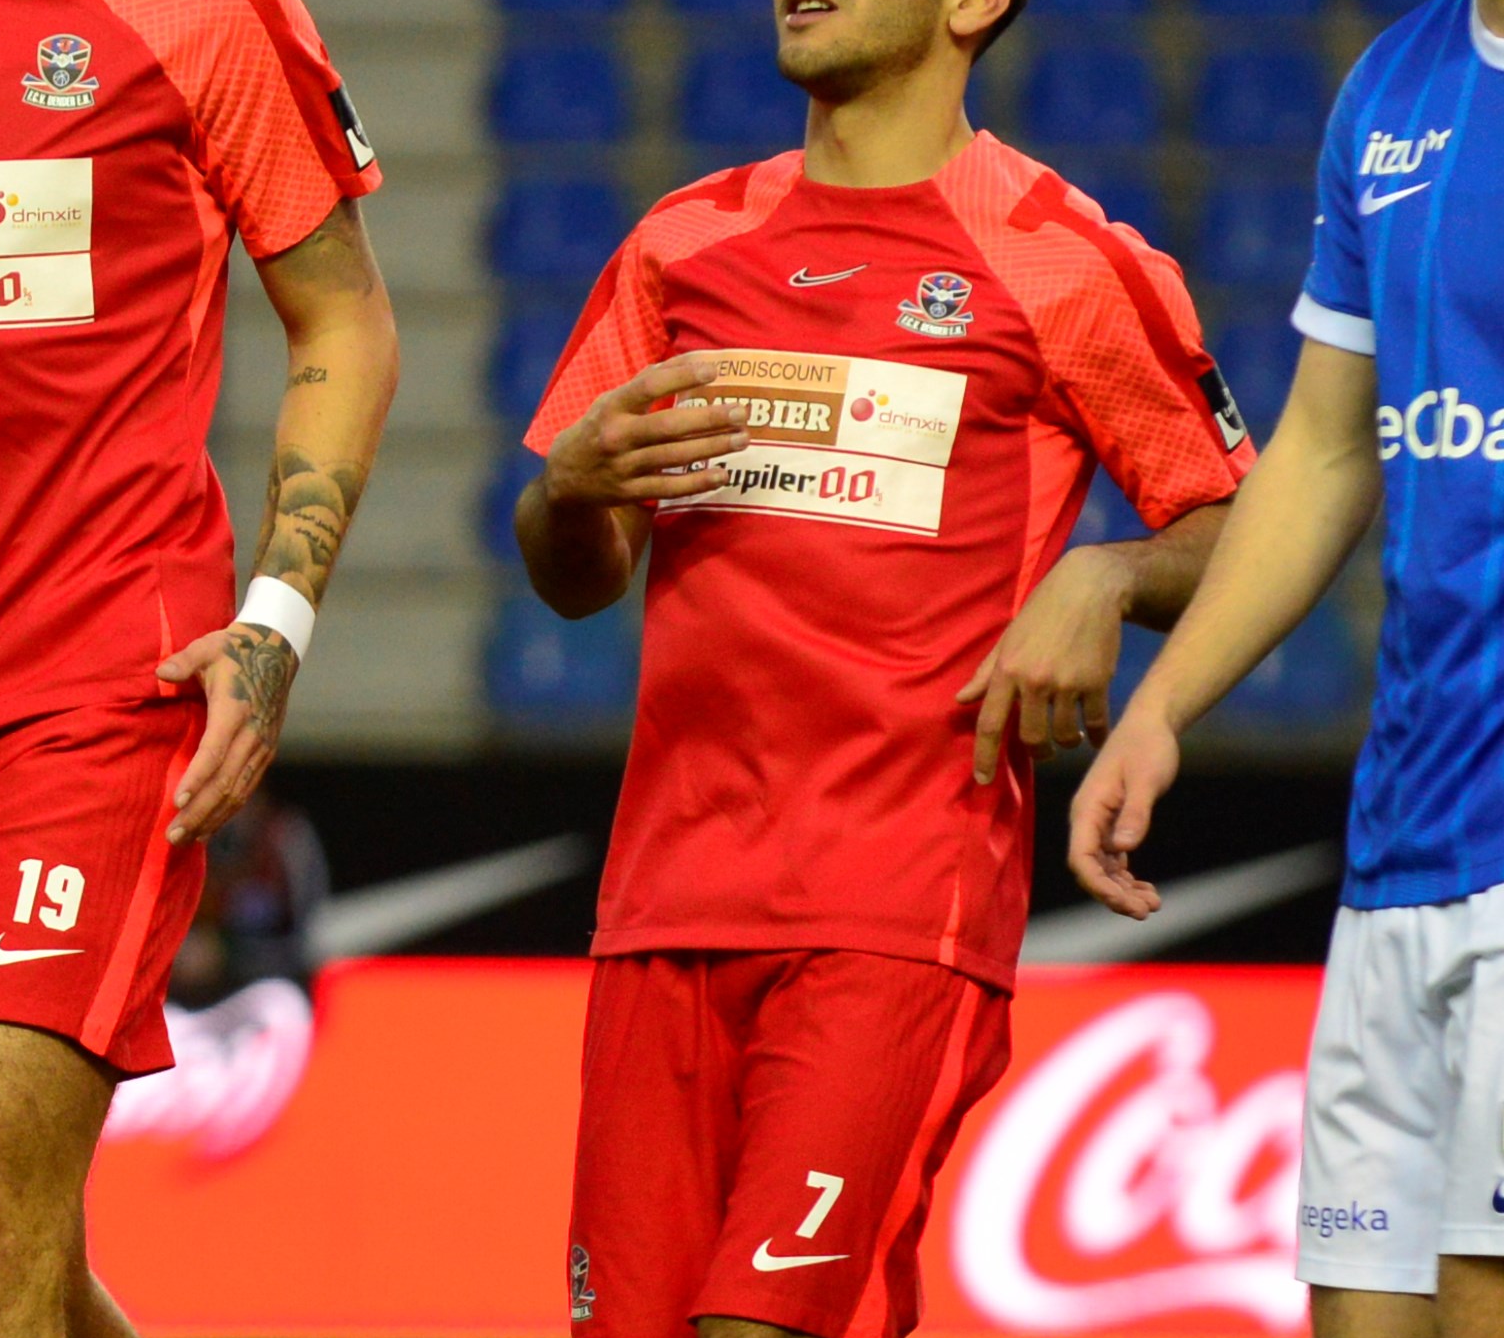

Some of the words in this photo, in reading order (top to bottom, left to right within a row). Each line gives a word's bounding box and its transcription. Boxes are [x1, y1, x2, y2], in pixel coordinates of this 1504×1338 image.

[11, 208, 82, 224] drinxit
[713, 359, 837, 383] ENDISCOUNT
[878, 409, 947, 434] drinxit
[13, 859, 85, 932] 19
[795, 1170, 844, 1239] 7
[1302, 1200, 1389, 1238] cegeka
